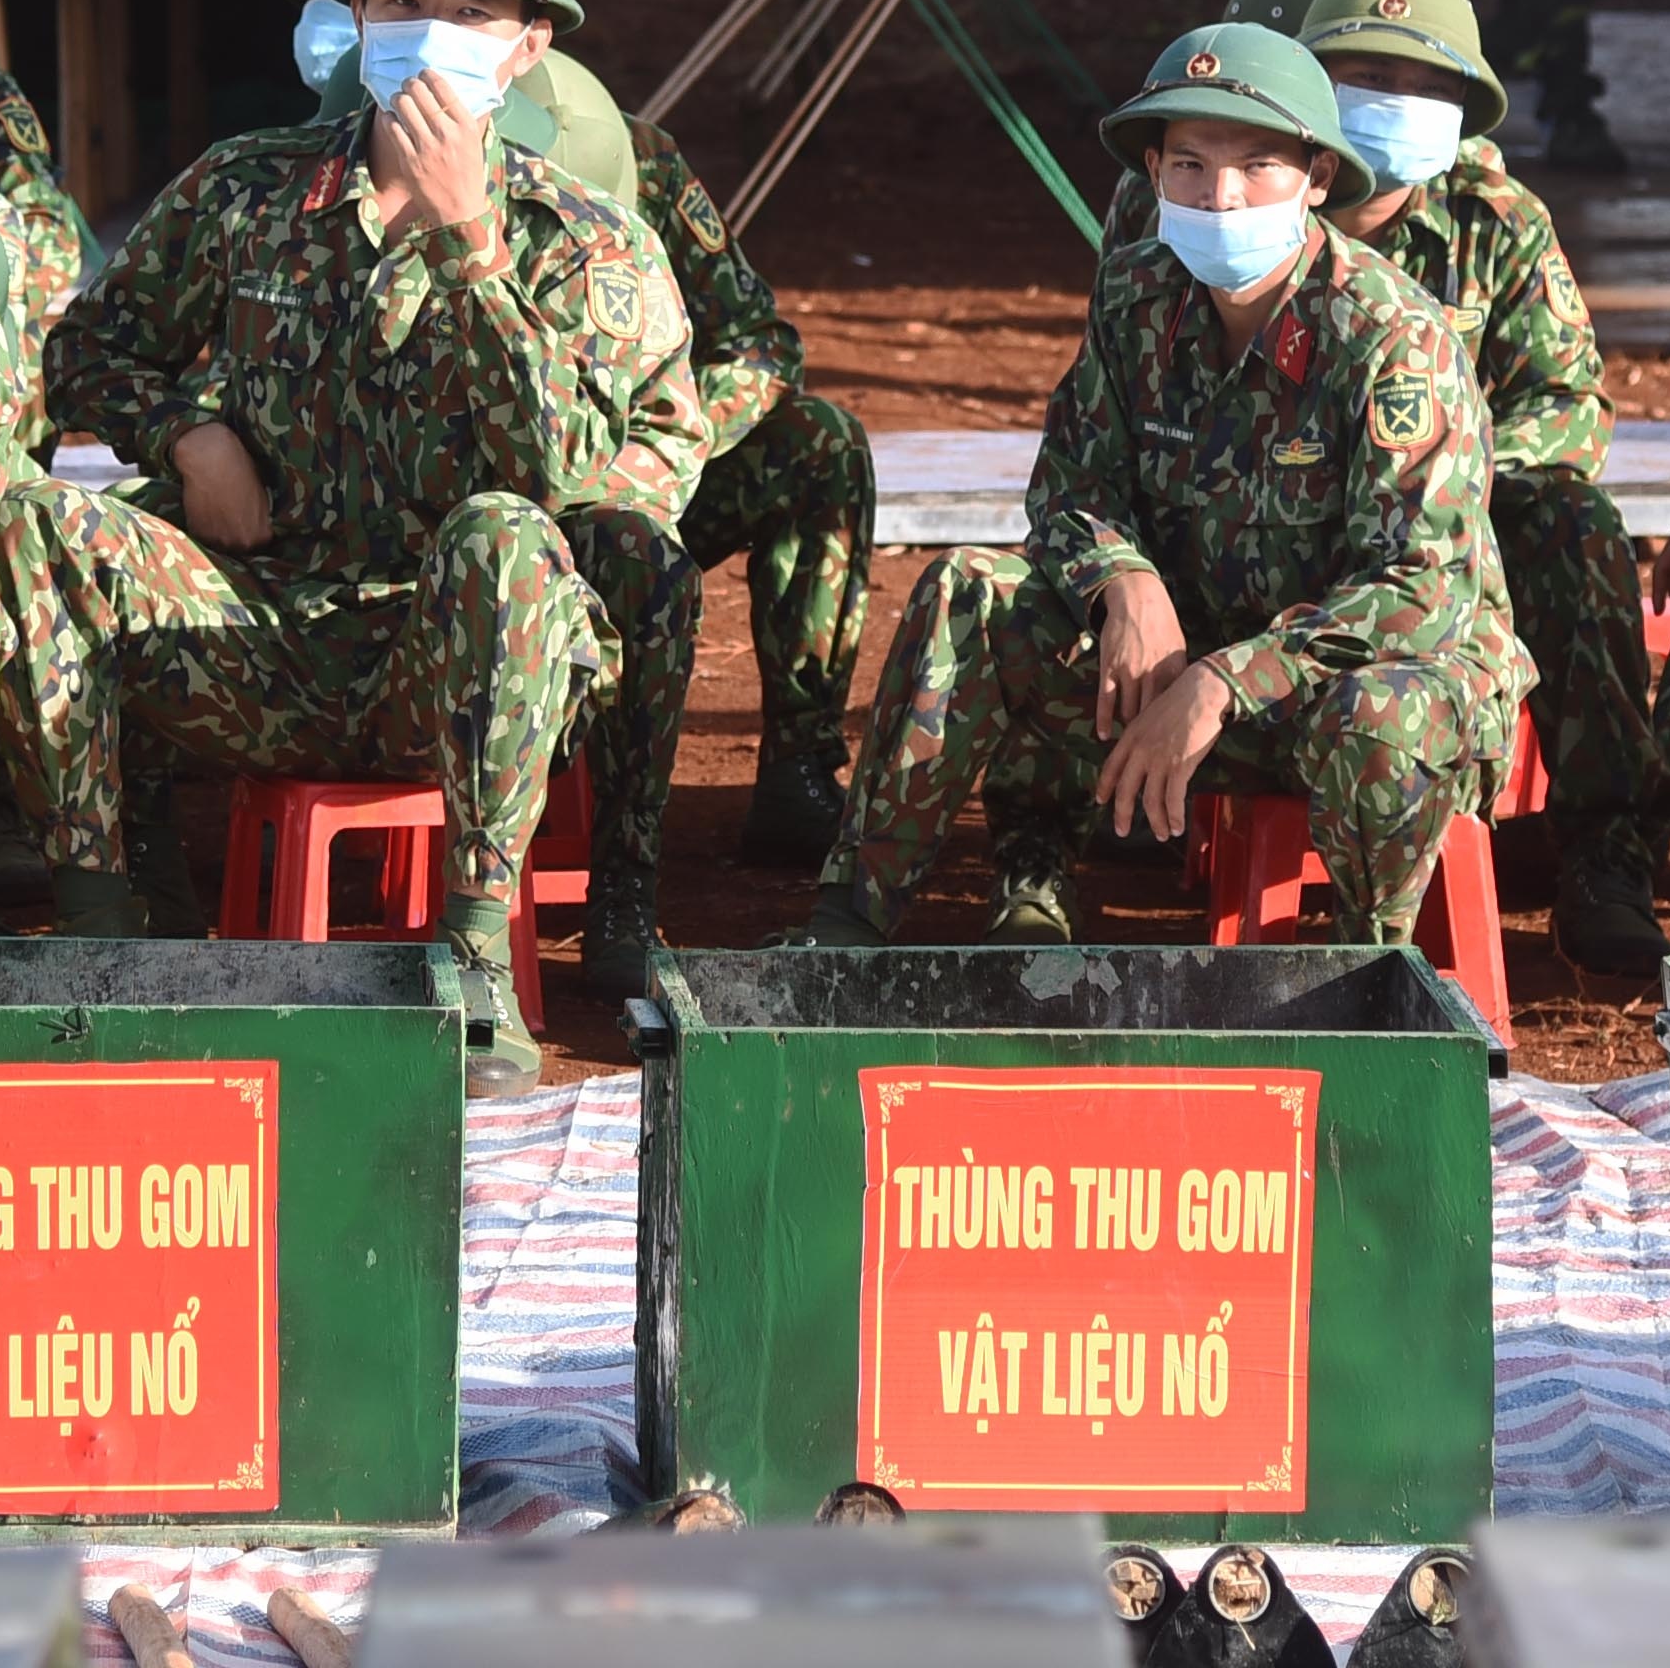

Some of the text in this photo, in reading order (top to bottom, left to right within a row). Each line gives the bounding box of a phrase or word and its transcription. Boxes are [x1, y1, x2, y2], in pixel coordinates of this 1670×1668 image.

[30, 1165, 122, 1250] THU
[140, 1162, 251, 1248] GOM
[894, 1148, 1287, 1255] THÙNG THU GOM
[8, 1315, 113, 1436] LIỆU
[131, 1296, 200, 1416] NỔ
[939, 1301, 1233, 1435] VẬT LIỆU NỔ
